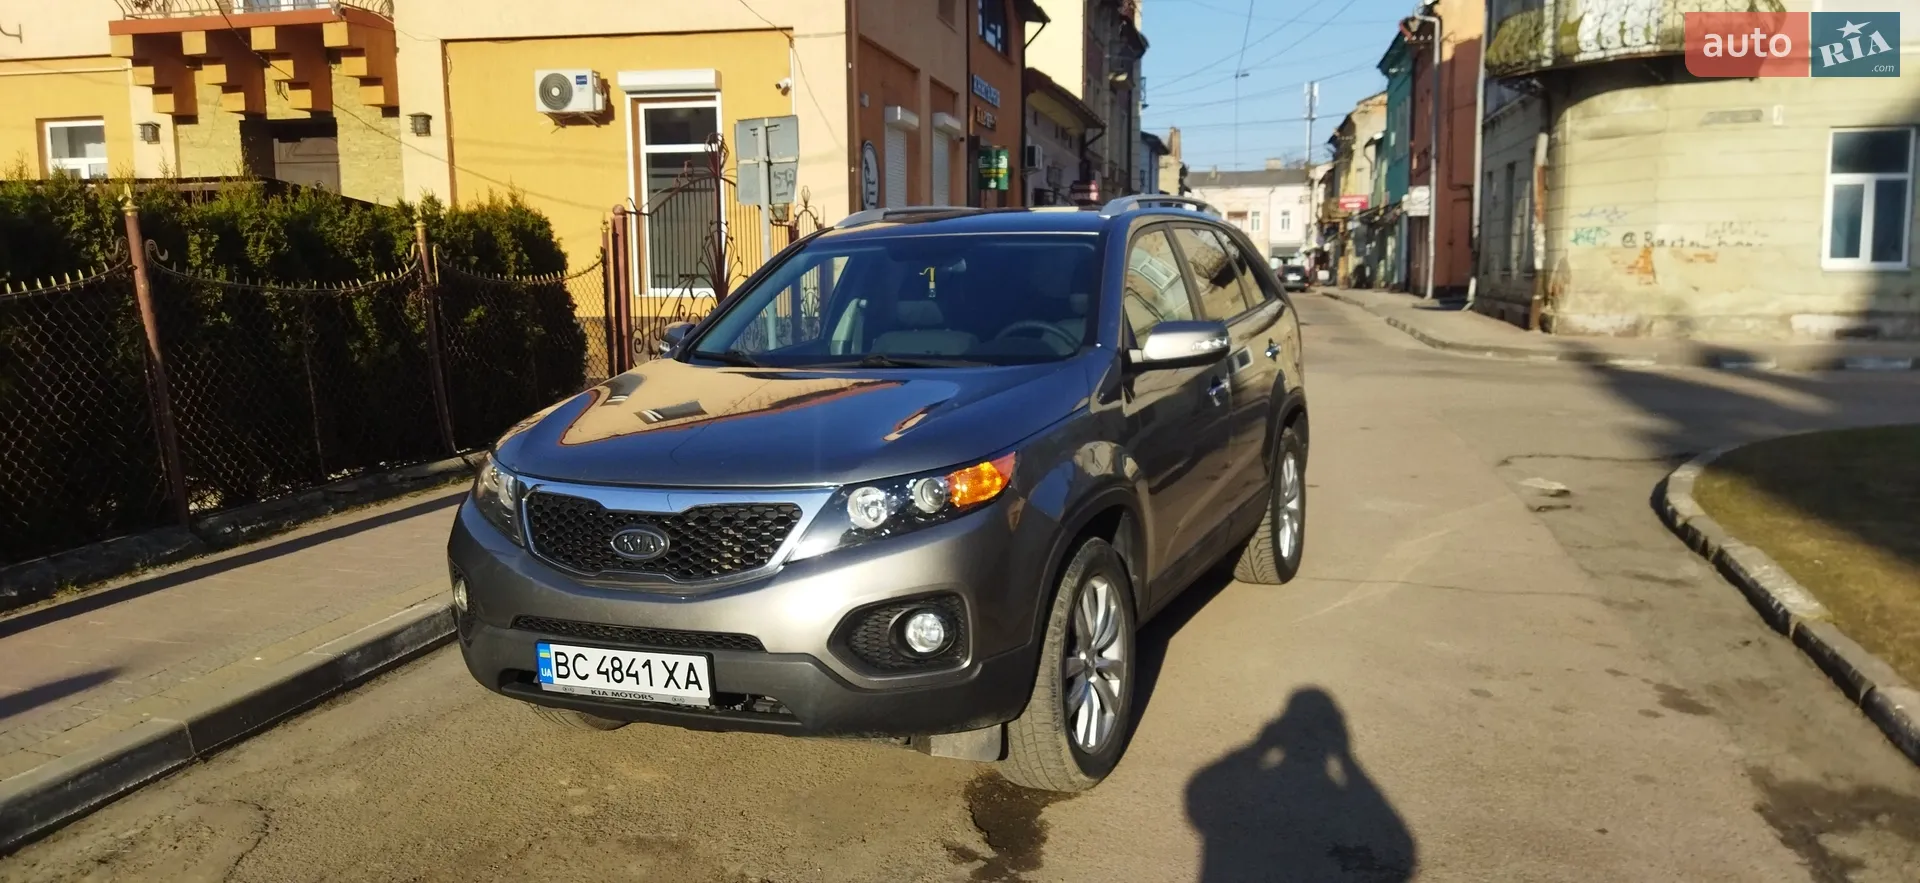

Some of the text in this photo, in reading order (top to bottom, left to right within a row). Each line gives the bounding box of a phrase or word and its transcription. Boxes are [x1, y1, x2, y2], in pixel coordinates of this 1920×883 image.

[621, 534, 657, 552] KIA
[541, 667, 552, 677] UA
[554, 651, 703, 691] BC 4841 XA
[591, 689, 655, 701] KIA MOTORS
